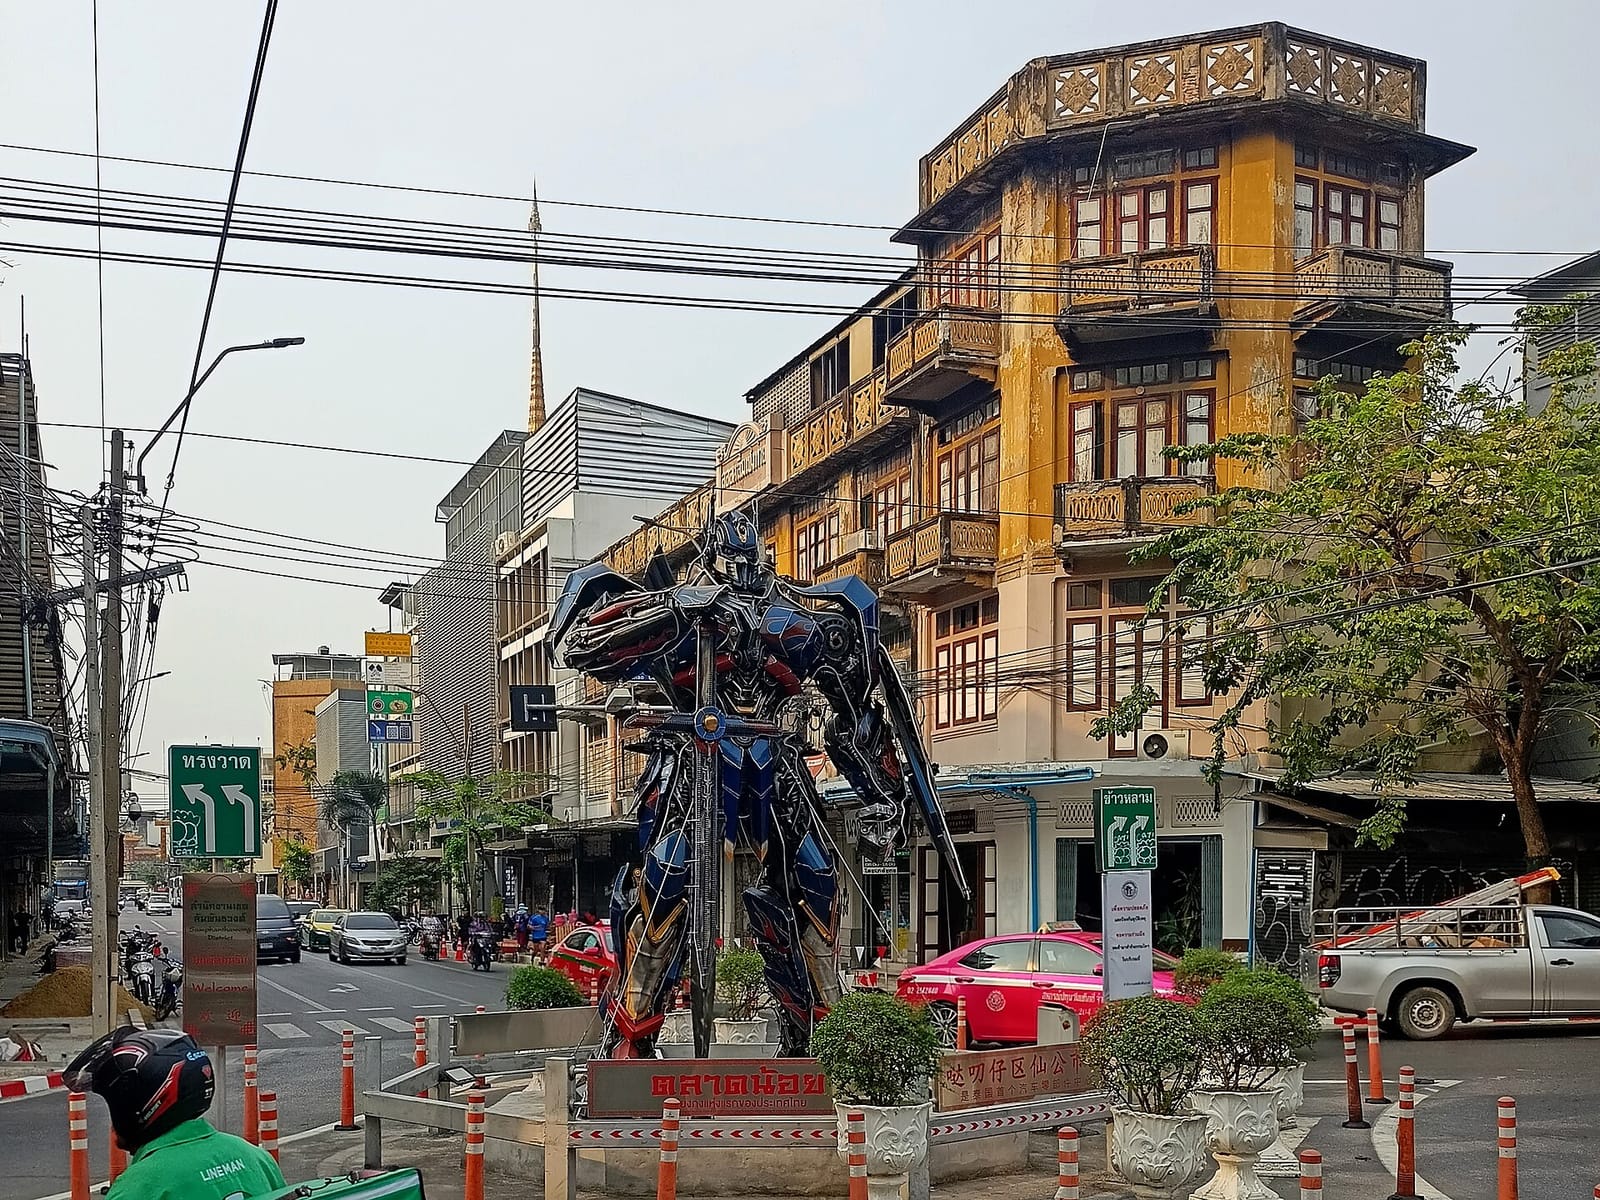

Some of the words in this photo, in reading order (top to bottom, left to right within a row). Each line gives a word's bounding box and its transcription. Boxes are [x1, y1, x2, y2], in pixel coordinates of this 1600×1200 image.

[182, 755, 251, 769] ทรงวาด
[1103, 790, 1153, 805] ข้าวหลาม
[191, 982, 249, 993] Welcome
[200, 1008, 241, 1024] 欢迎
[651, 1066, 826, 1096] ตลาดน้อย
